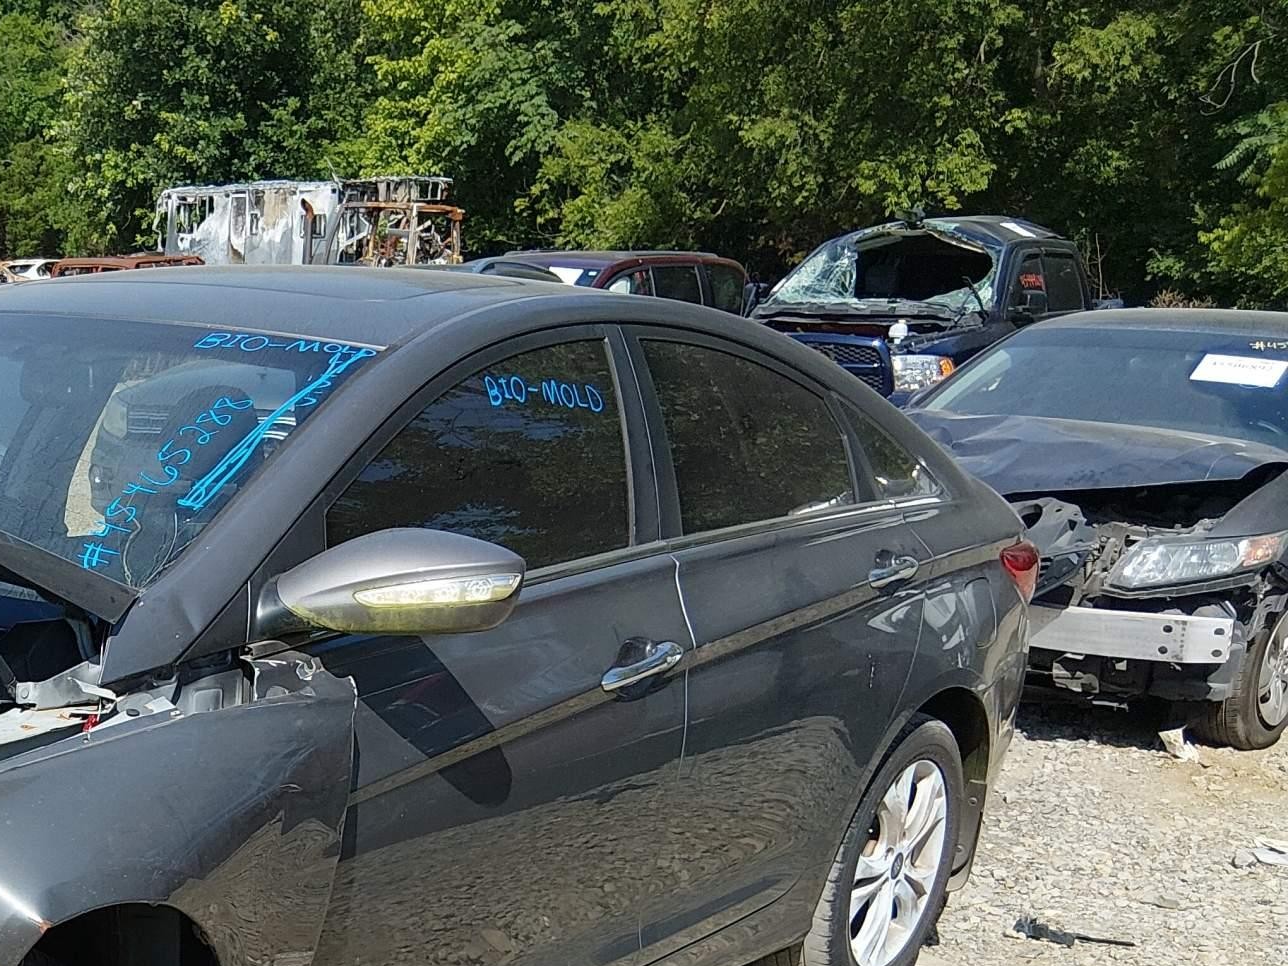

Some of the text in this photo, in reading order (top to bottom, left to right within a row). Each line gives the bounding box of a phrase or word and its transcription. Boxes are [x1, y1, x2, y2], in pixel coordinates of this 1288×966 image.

[194, 333, 377, 357] BIO-MOLD
[485, 376, 603, 412] BIO-MOLD
[77, 396, 253, 569] #45465288
